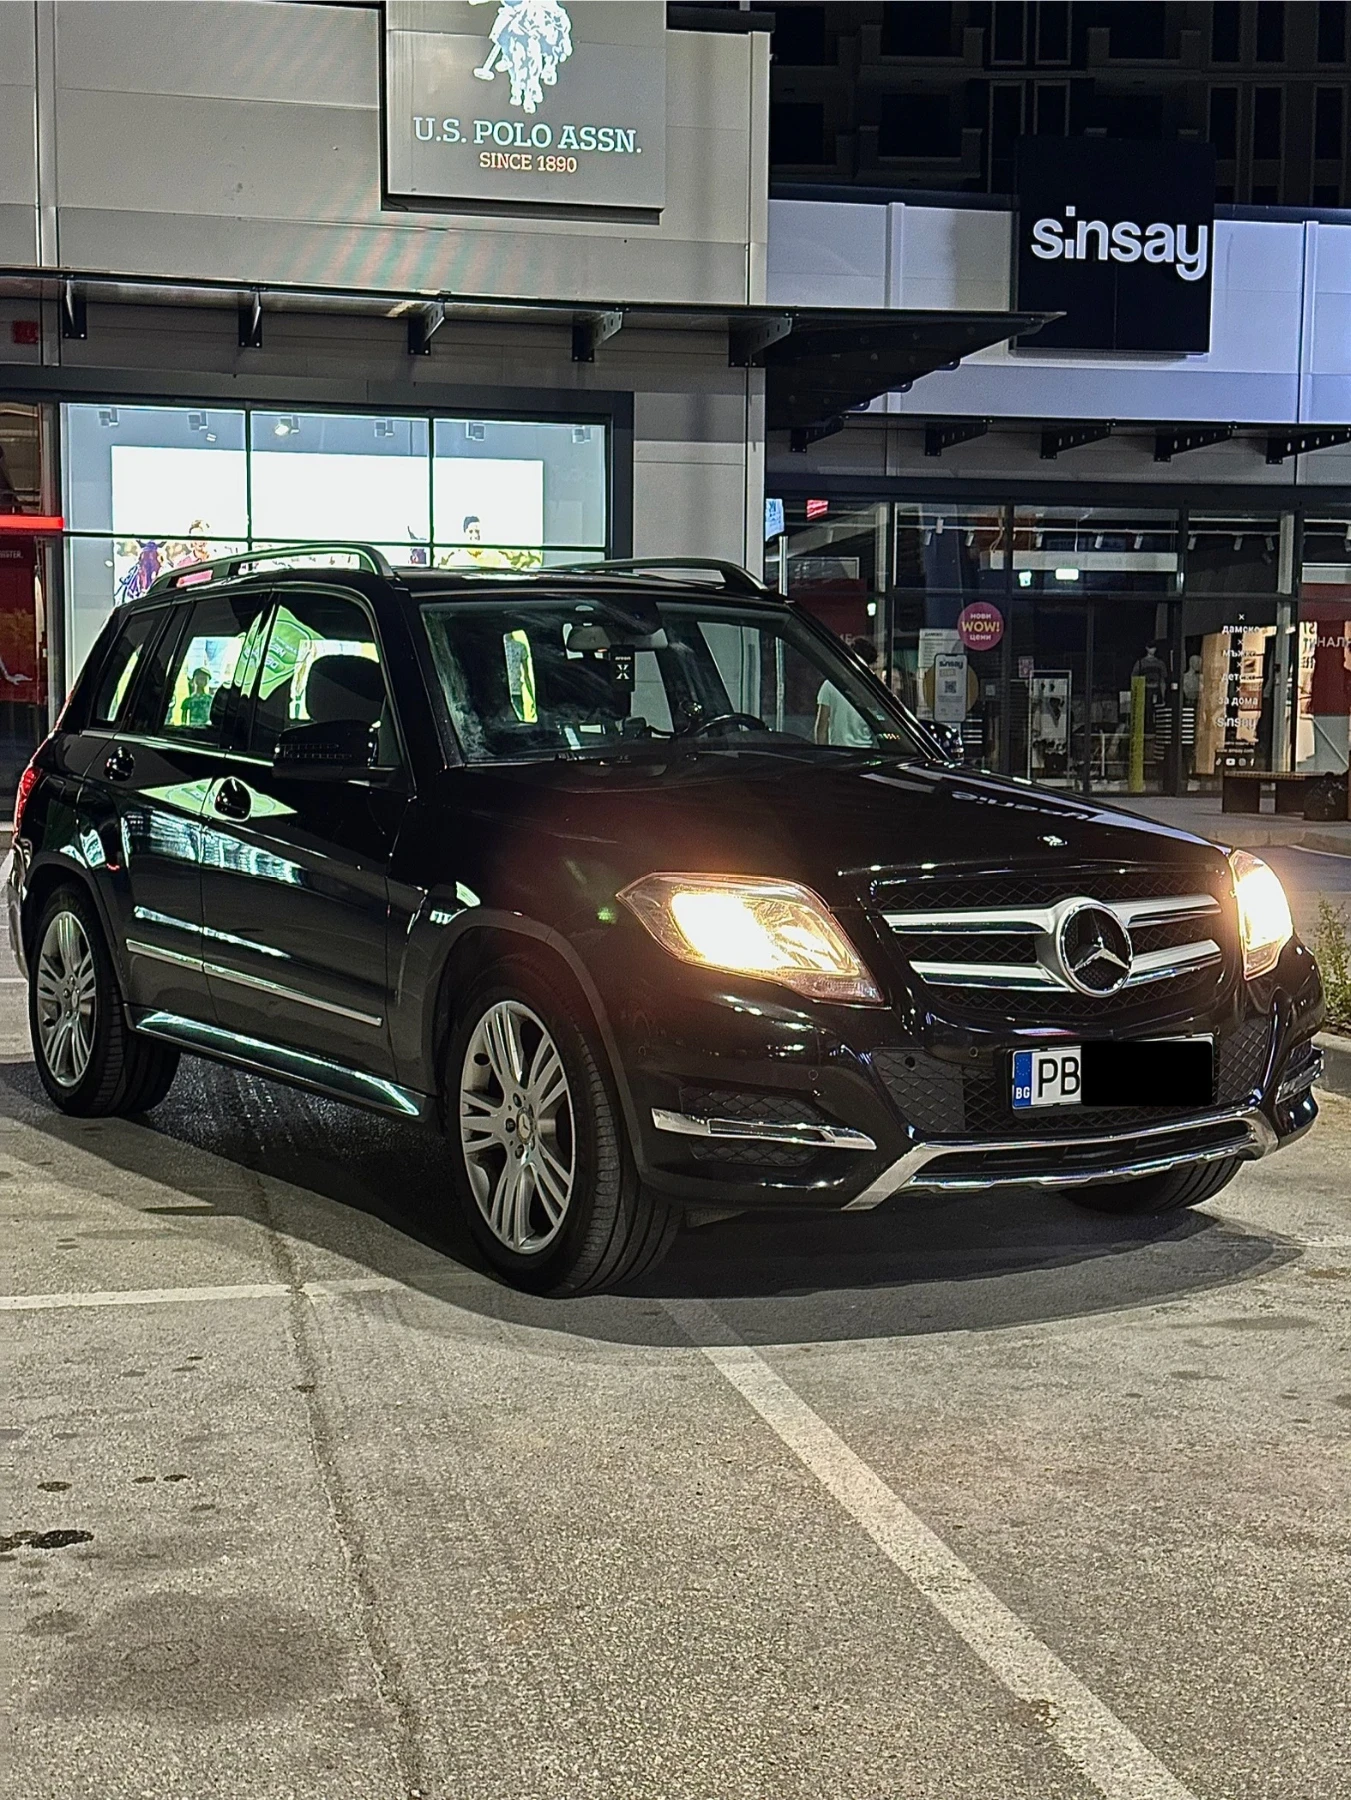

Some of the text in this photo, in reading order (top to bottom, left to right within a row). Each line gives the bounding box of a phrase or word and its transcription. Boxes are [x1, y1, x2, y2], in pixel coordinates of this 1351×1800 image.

[413, 116, 642, 153] U.S. POLO ASSN.
[479, 152, 577, 173] SINCE 1890
[1031, 205, 1208, 281] sinsay
[961, 621, 1000, 632] WOW!
[1231, 696, 1258, 707] дома
[1015, 1086, 1031, 1100] BG
